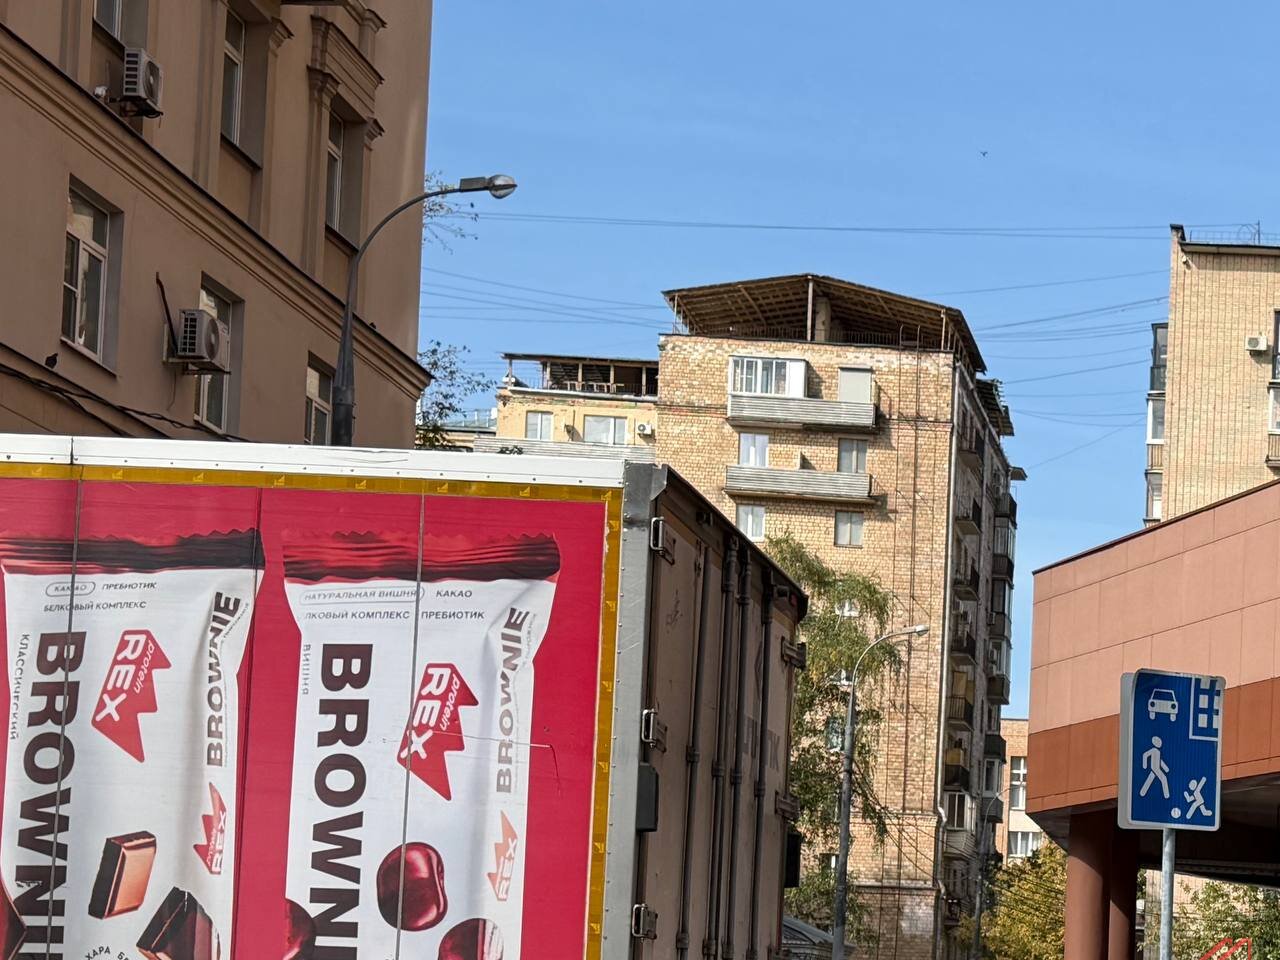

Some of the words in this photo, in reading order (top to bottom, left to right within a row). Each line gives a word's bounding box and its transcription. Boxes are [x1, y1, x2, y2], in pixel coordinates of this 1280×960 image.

[102, 582, 157, 590] ПРЕБИОТИК
[304, 590, 376, 600] НАТУРАЛЬНАЯ
[436, 590, 473, 598] КАКАО
[96, 601, 147, 610] КОМПЛЕКС
[351, 611, 410, 620] КОМПЛЕКС
[421, 611, 485, 620] ПРЕБИОТИК
[95, 634, 147, 722] REX
[133, 639, 156, 694] protein
[206, 591, 241, 767] BROWNIE
[10, 634, 30, 740] КЛАССИЧЕСКИЙ
[440, 674, 460, 731] protein
[400, 667, 451, 760] REX
